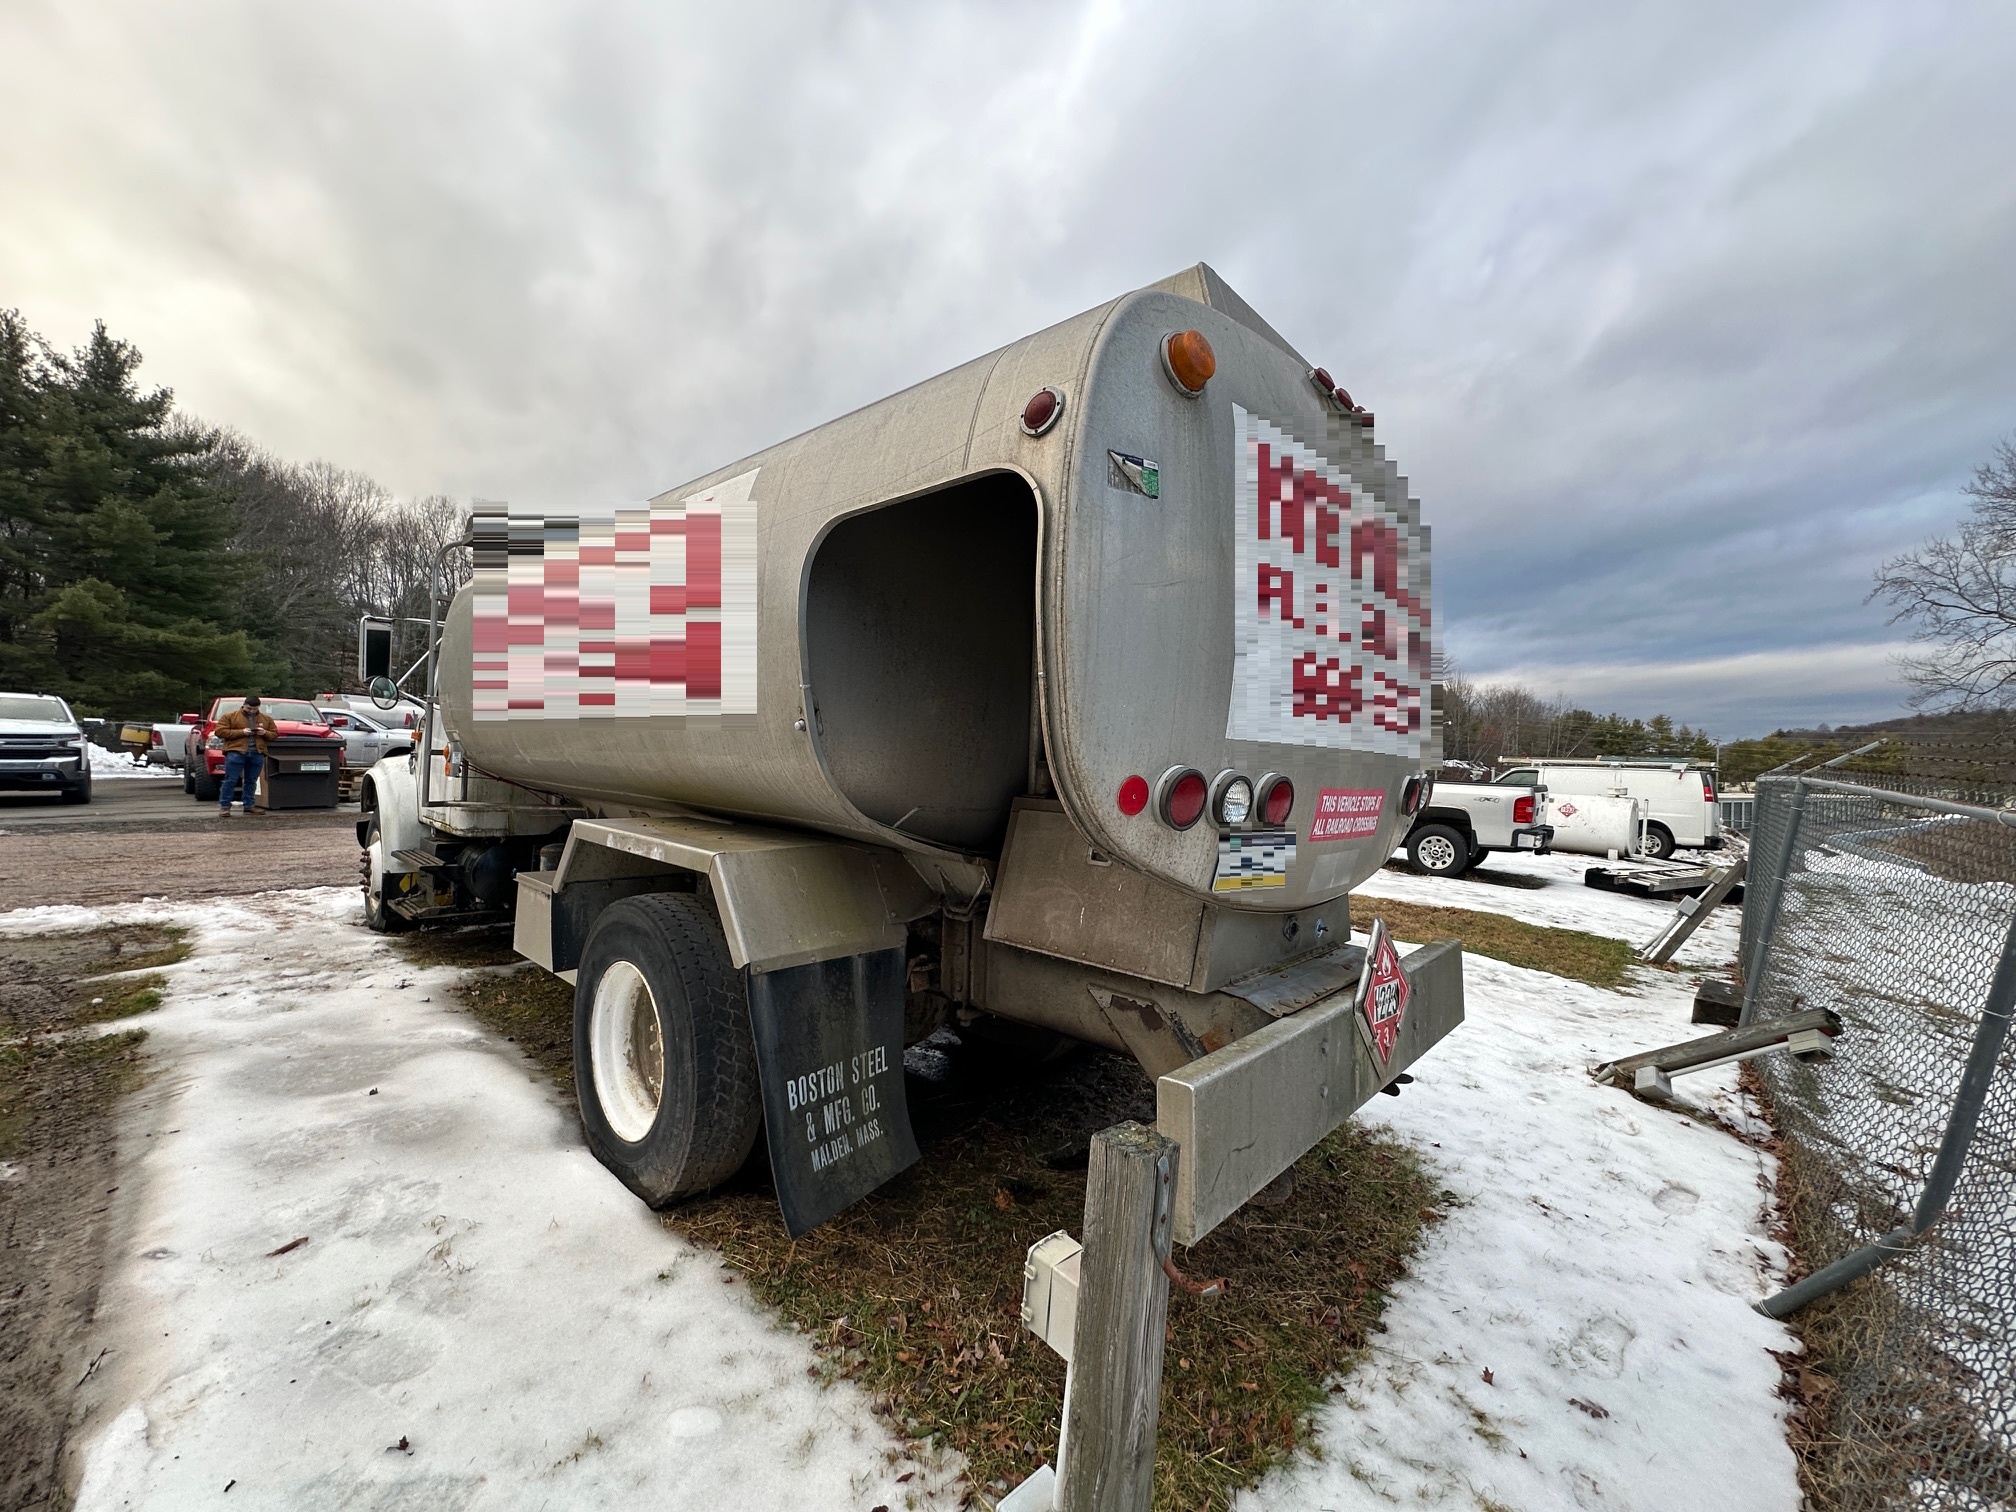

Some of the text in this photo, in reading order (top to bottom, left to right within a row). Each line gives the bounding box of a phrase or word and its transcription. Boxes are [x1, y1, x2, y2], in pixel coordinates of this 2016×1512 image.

[1321, 795, 1383, 812] THIS VEHICLE STOPS AT
[1312, 816, 1379, 835] ALL RAILROAD CROSSINGS
[787, 1045, 888, 1111] BOSTON STEEL
[805, 1084, 880, 1142] & MFG. CO.
[856, 1118, 883, 1147] MASS.
